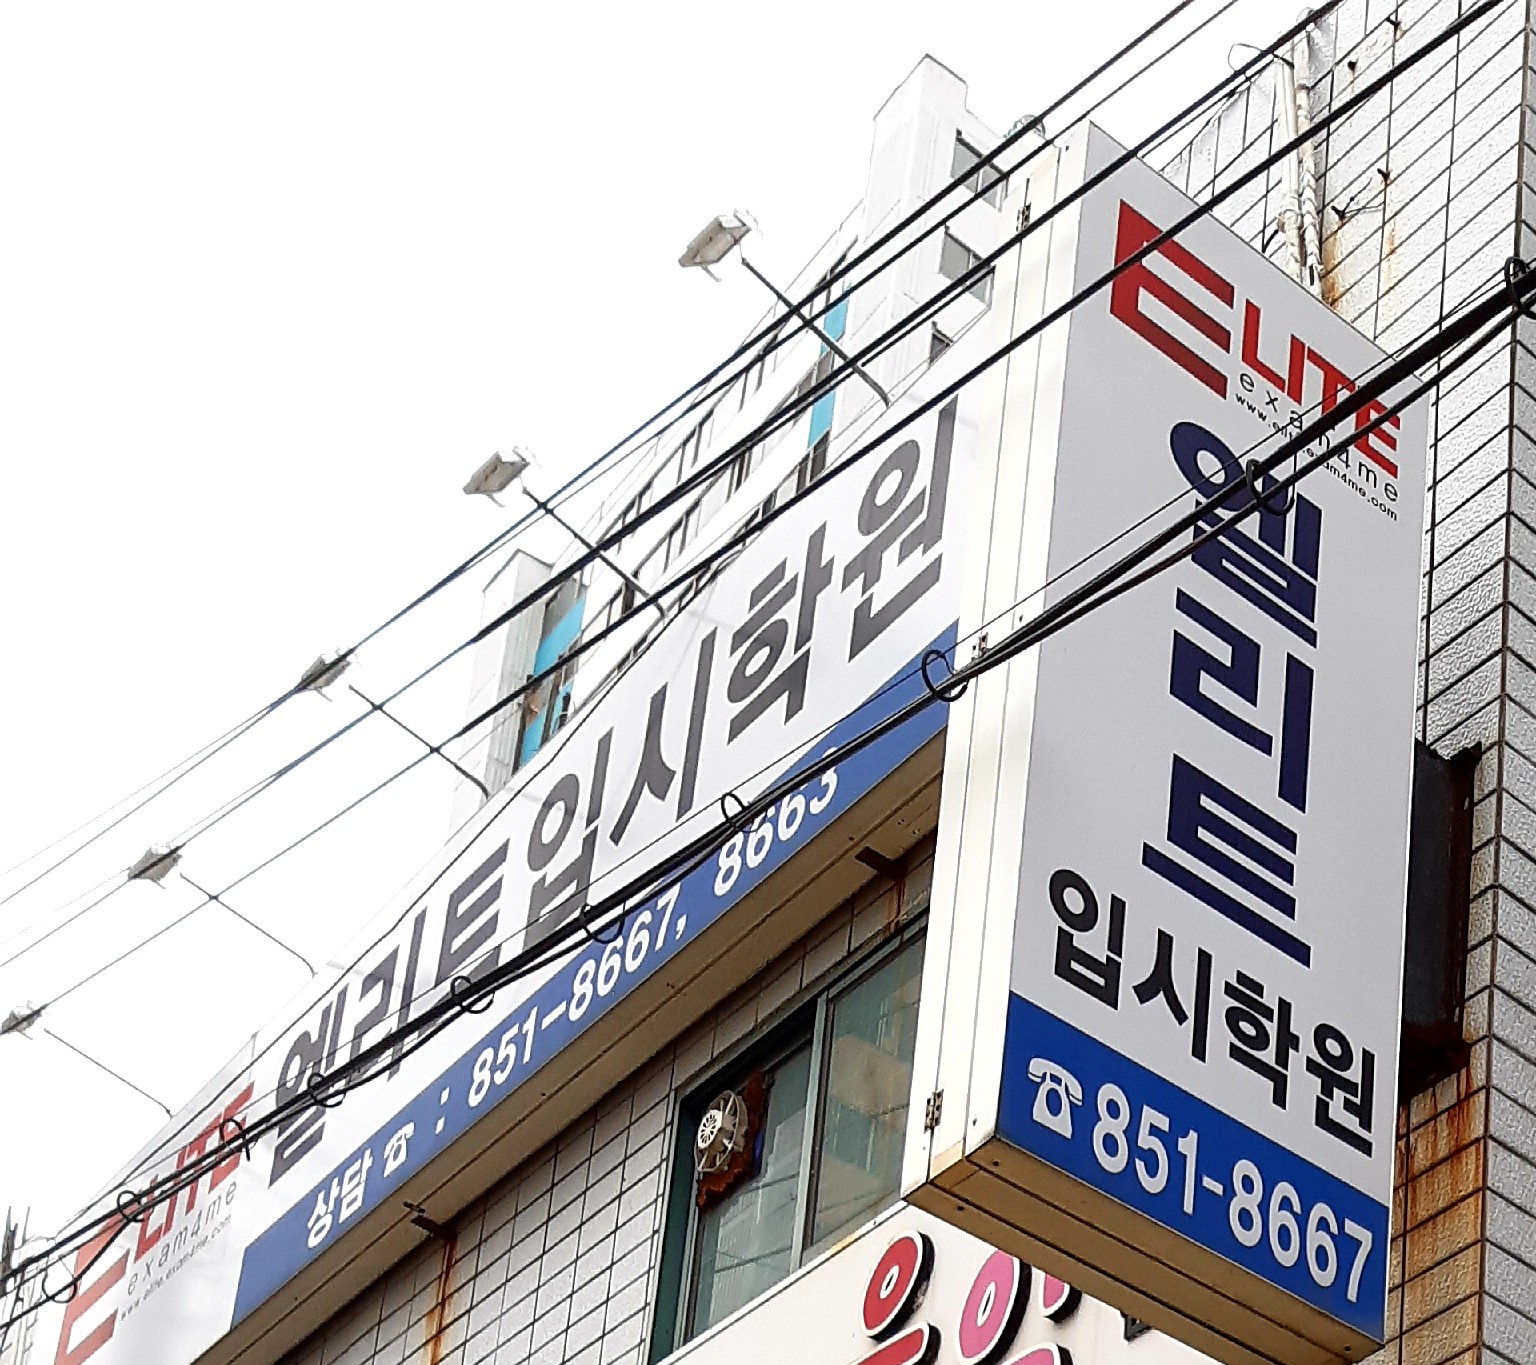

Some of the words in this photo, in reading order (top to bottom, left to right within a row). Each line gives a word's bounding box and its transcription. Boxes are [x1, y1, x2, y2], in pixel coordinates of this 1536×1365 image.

[1109, 199, 1400, 479] ELITE
[268, 394, 960, 1189] 엘리트입시학원
[1142, 421, 1322, 968] 엘리트
[307, 1152, 373, 1250] 상담
[711, 746, 840, 899] 8663
[1049, 868, 1374, 1158] 입시학원
[127, 1181, 237, 1296] exam4me
[1092, 1083, 1373, 1303] 851-8667
